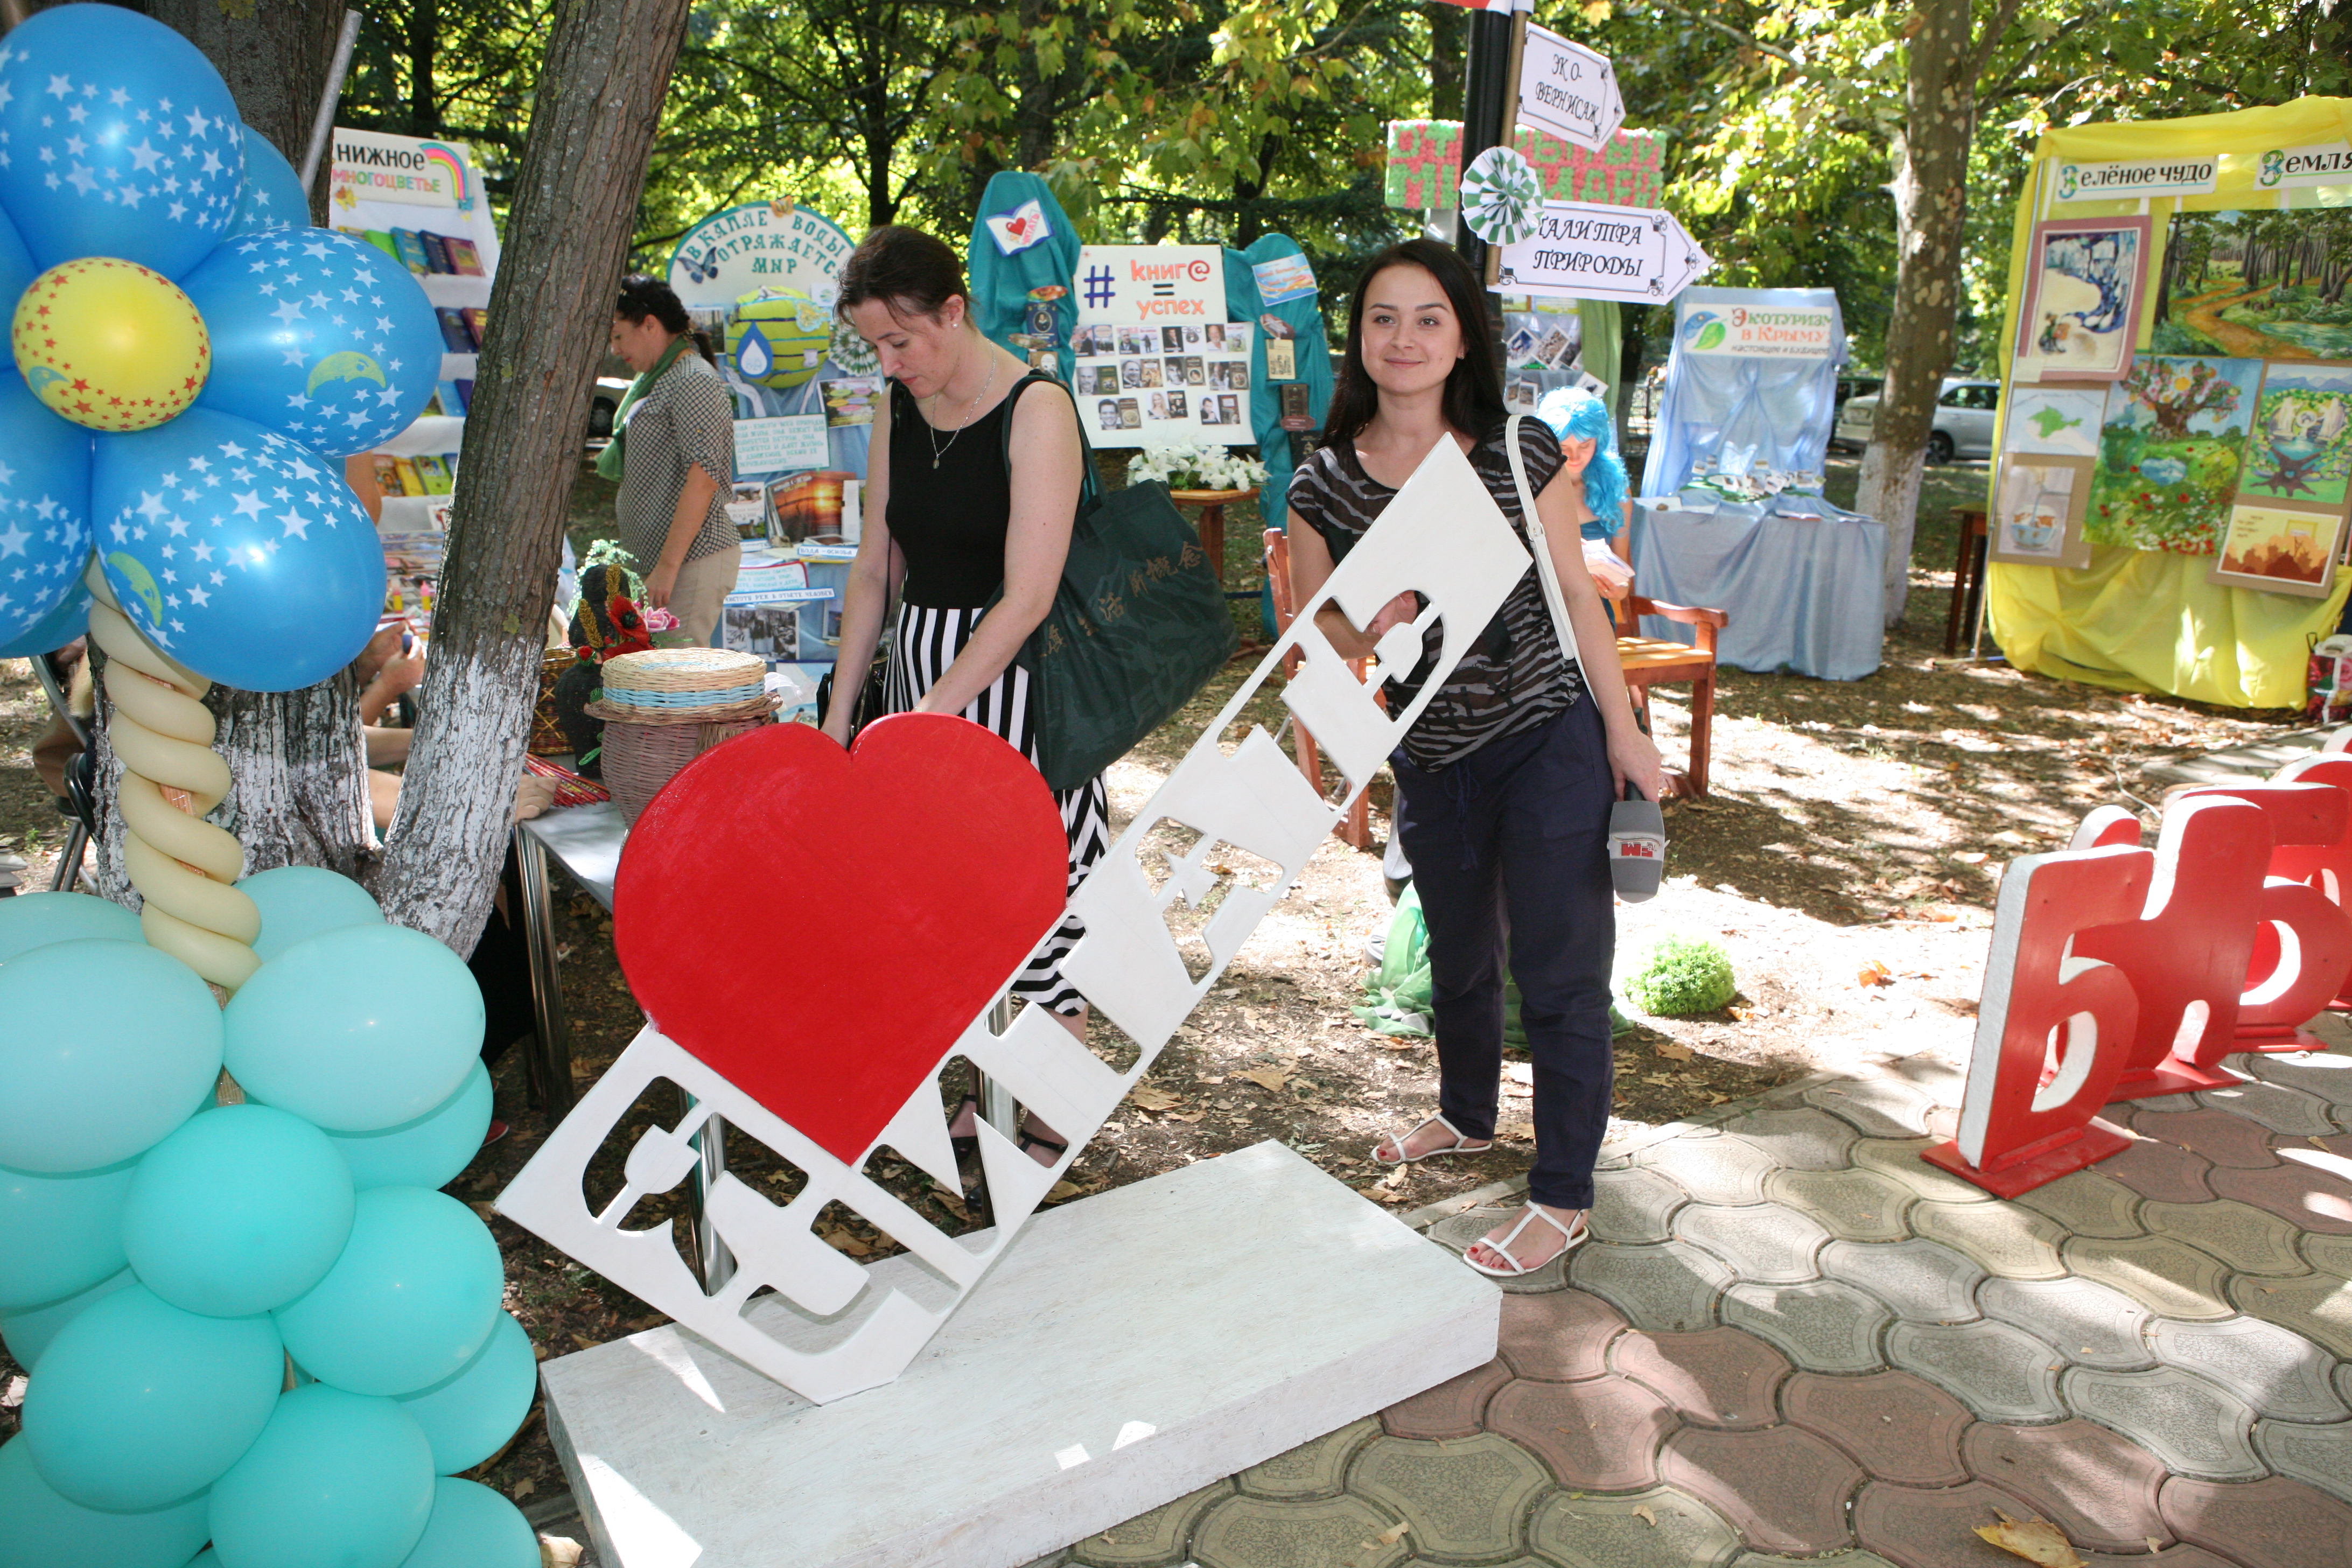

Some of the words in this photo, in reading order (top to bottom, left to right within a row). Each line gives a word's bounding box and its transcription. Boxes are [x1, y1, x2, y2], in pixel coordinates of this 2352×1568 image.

[1536, 81, 1599, 122] ВЕРНИСАЖ
[332, 170, 440, 192] МНОГОЦВЕТЬЕ
[2059, 165, 2156, 199] Зелёное
[2160, 164, 2213, 185] чудо
[686, 245, 701, 260] В
[697, 209, 768, 247] КАПЛЕ
[792, 215, 846, 257] ВОДЫ
[752, 257, 797, 274] МИР
[1532, 249, 1644, 276] ПРИРОДЫ
[1136, 299, 1205, 320] успех
[736, 588, 1446, 1359] ЧИТАТЬ
